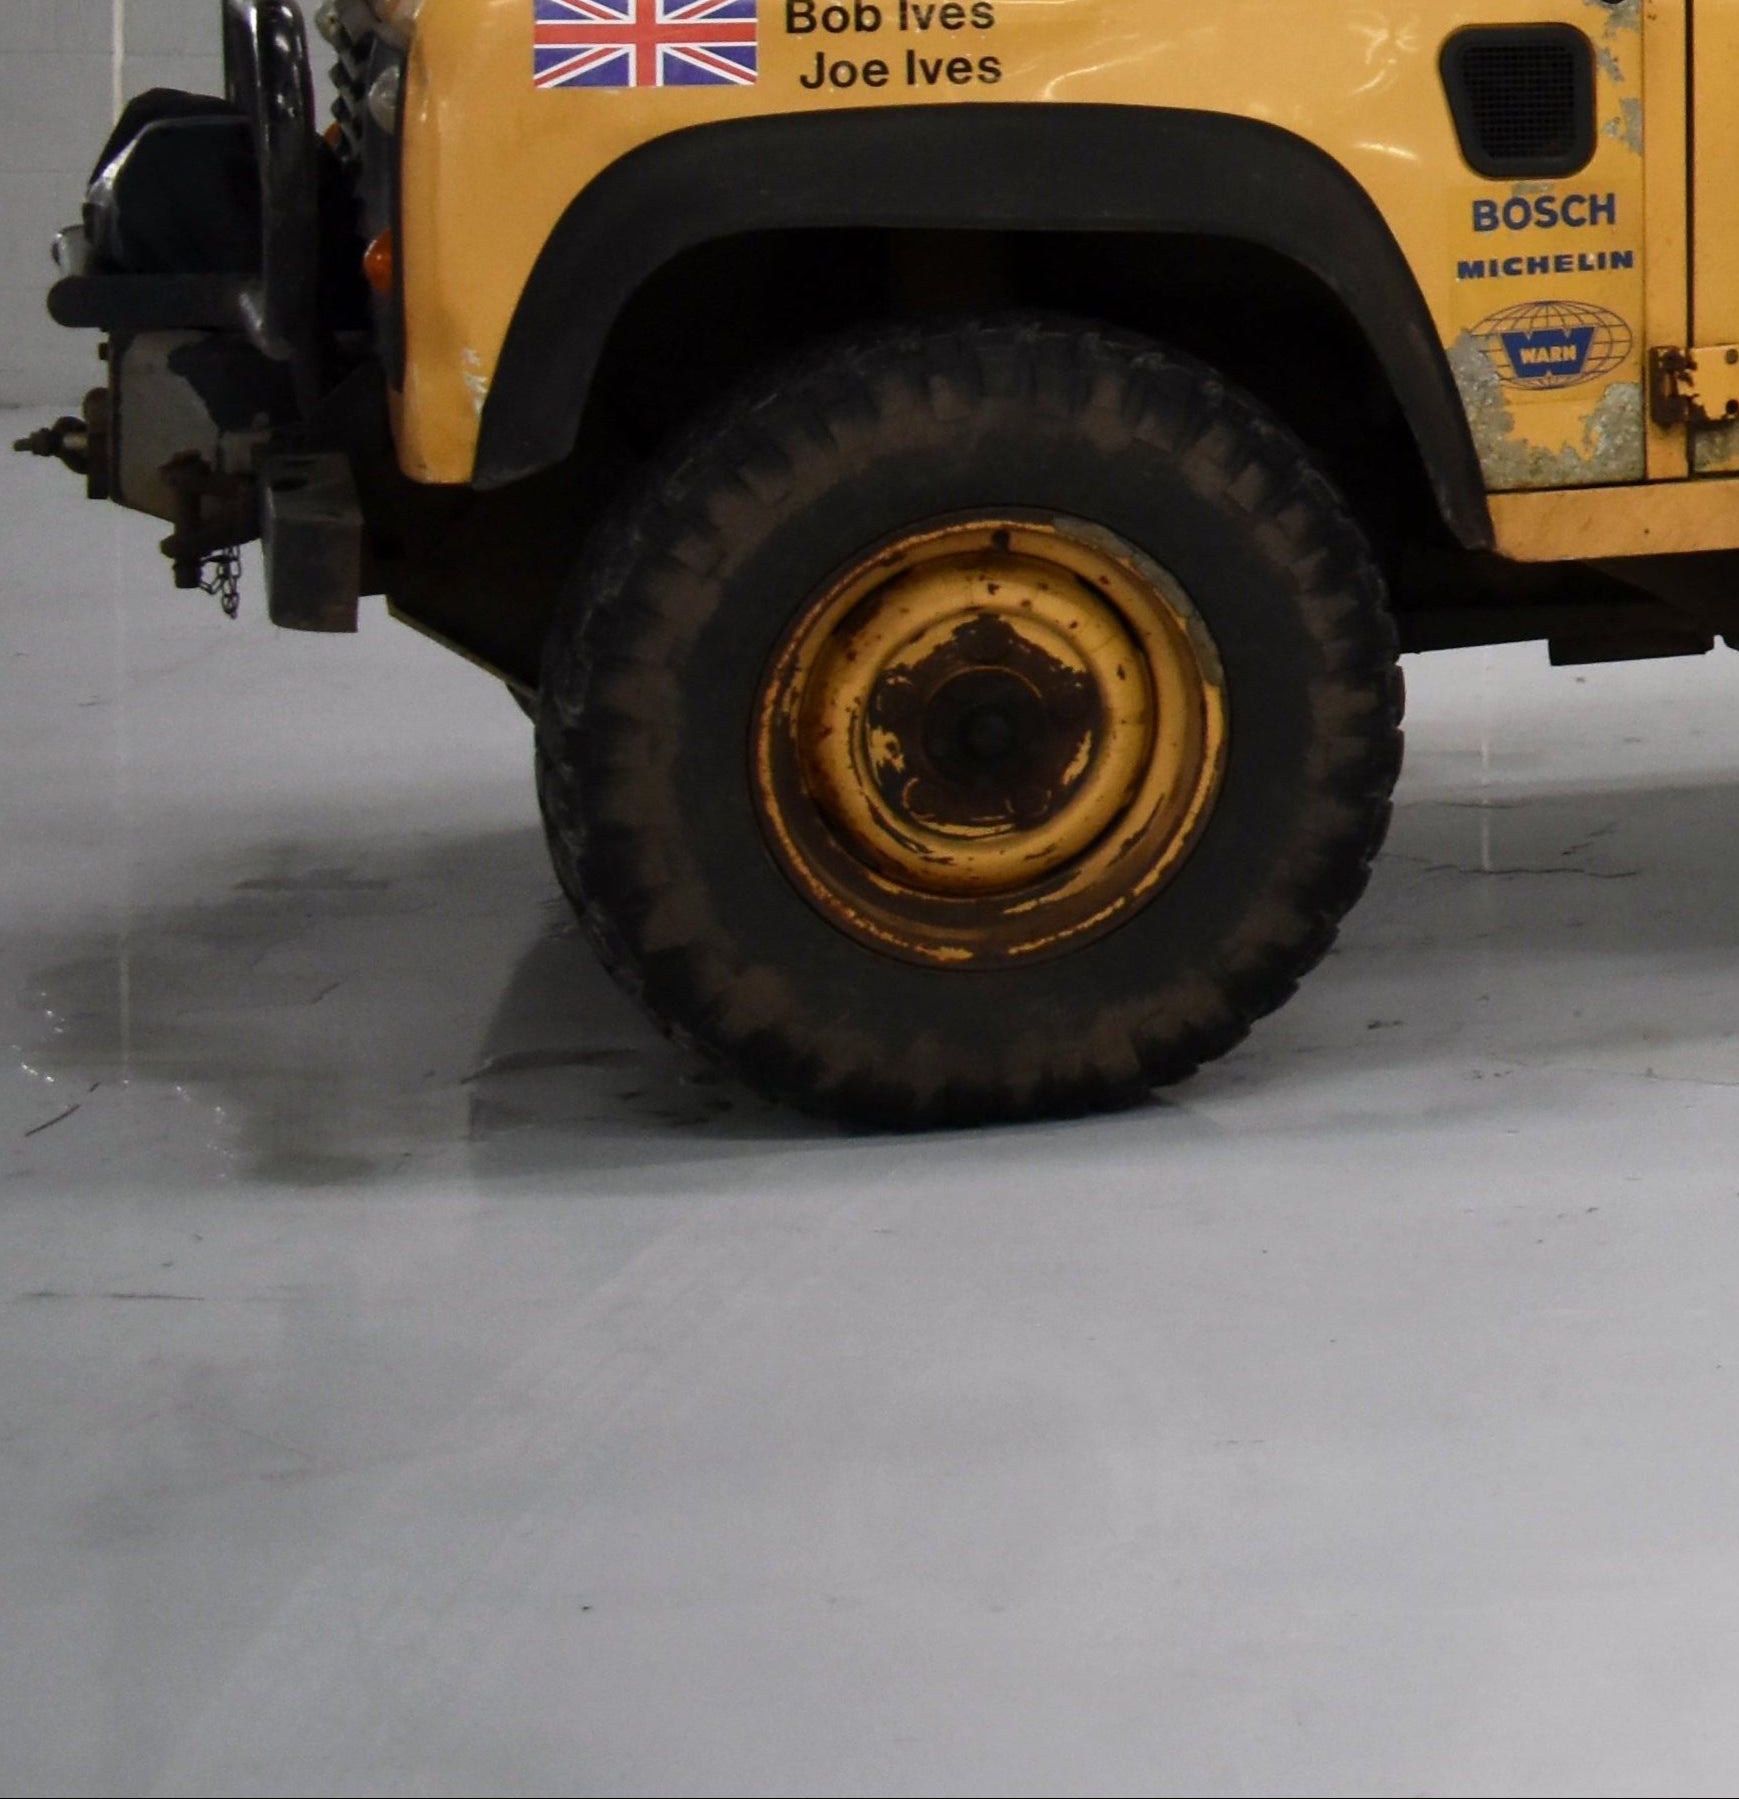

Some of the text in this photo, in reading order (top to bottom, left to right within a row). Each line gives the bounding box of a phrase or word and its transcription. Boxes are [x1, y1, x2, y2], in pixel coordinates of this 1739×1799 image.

[799, 50, 1003, 89] Joe Ives
[1472, 192, 1616, 233] BOSCH
[1457, 249, 1634, 280] MICHELIN
[1519, 344, 1578, 365] WARN
